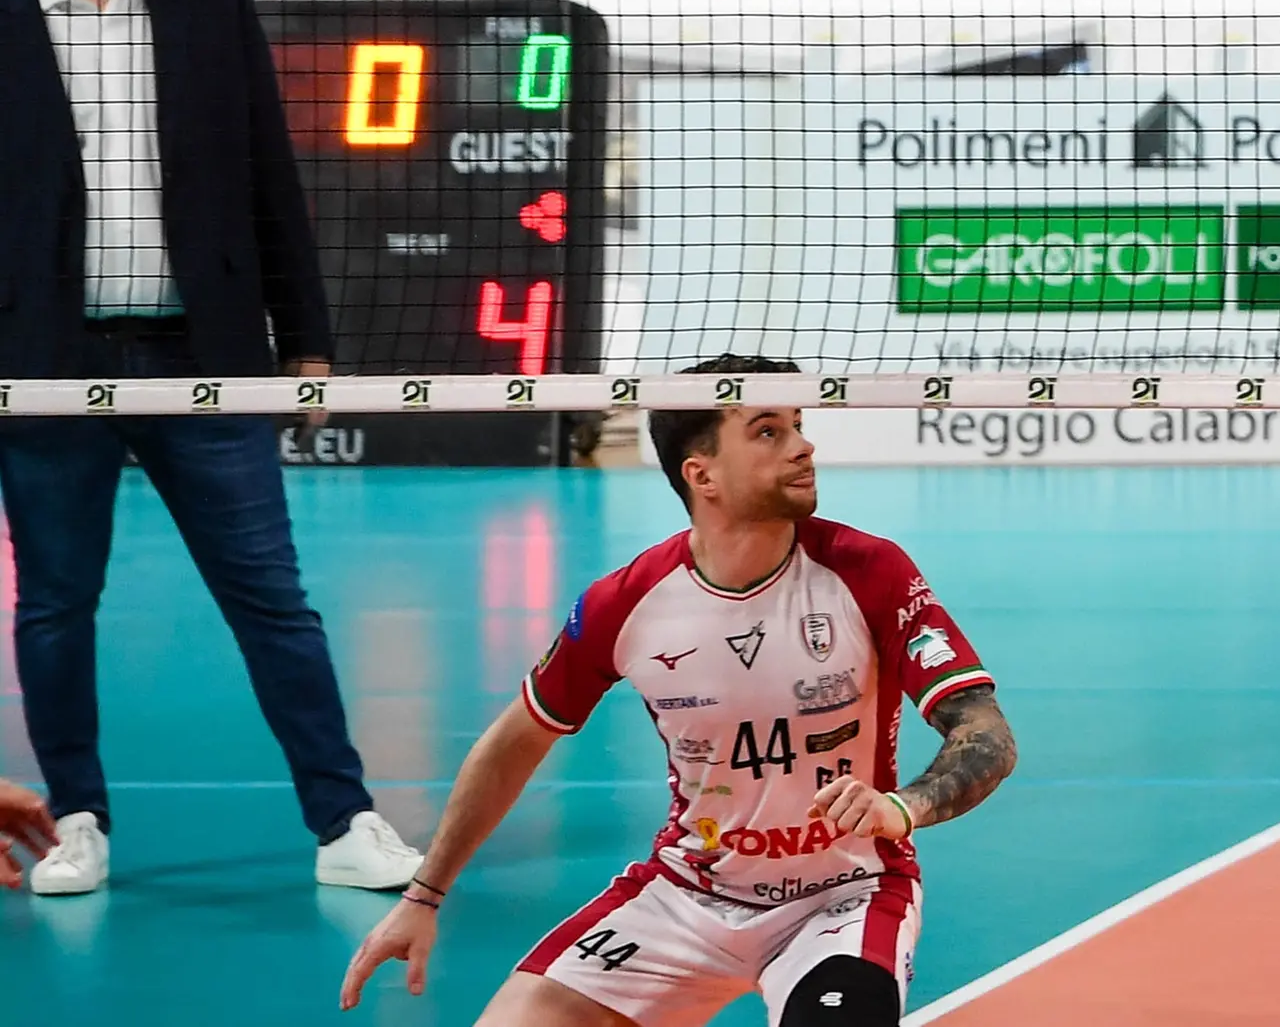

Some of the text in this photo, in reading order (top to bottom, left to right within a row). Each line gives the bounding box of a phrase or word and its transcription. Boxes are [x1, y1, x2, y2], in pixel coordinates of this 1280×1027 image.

[346, 44, 424, 145] 0
[518, 35, 571, 109] 0
[451, 131, 571, 173] GUEST
[857, 118, 1108, 168] Polimeni
[917, 231, 1206, 286] GAROFOLI
[478, 281, 551, 374] 4
[917, 406, 1096, 457] Reggio
[730, 718, 797, 780] 44
[721, 820, 848, 859] CONA
[575, 929, 640, 971] 44
